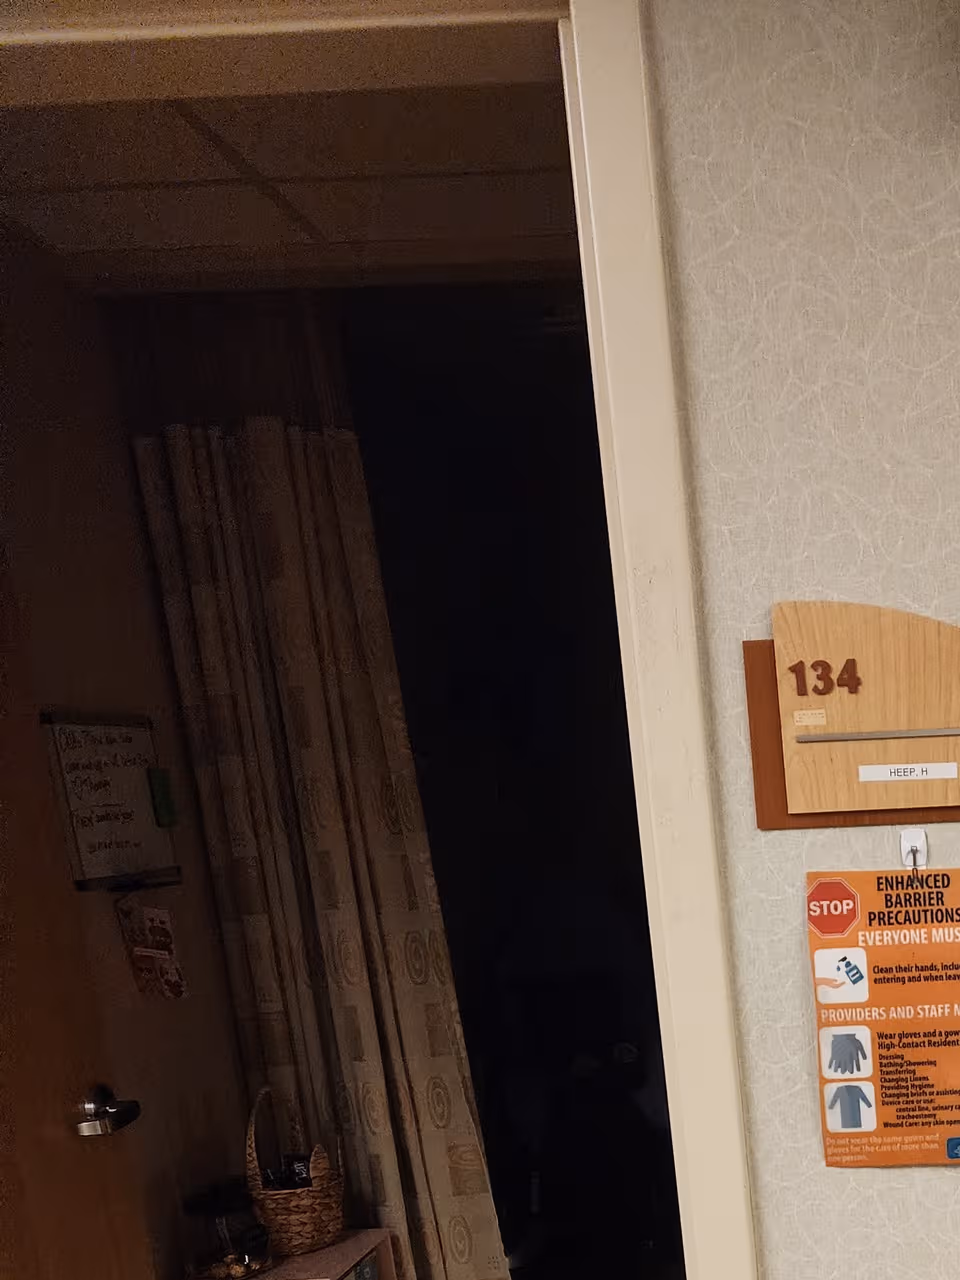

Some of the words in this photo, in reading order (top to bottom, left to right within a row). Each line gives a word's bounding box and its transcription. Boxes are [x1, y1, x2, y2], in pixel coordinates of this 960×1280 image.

[789, 658, 862, 696] 134
[920, 767, 928, 776] H
[877, 874, 951, 891] ENHANCED
[885, 892, 944, 908] BARRIER
[809, 900, 854, 916] STOP
[858, 929, 928, 947] EVERYONE
[873, 965, 894, 973] Clean
[896, 964, 914, 973] their
[915, 963, 940, 973] hands,
[873, 974, 906, 985] entering
[907, 973, 922, 982] and
[923, 972, 944, 981] when
[821, 1006, 886, 1022] PROVIDERS
[889, 1005, 914, 1019] AND
[917, 1003, 950, 1018] STAFF
[877, 1032, 896, 1040] Wear
[898, 1030, 921, 1041] gloves
[923, 1029, 937, 1038] and
[878, 1038, 926, 1050] High-Contact
[927, 1037, 960, 1047] Resident
[879, 1060, 937, 1068] Bathing/Showering
[881, 1091, 909, 1099] Changing
[918, 1105, 930, 1113] line,
[897, 1113, 936, 1121] tracheostomy
